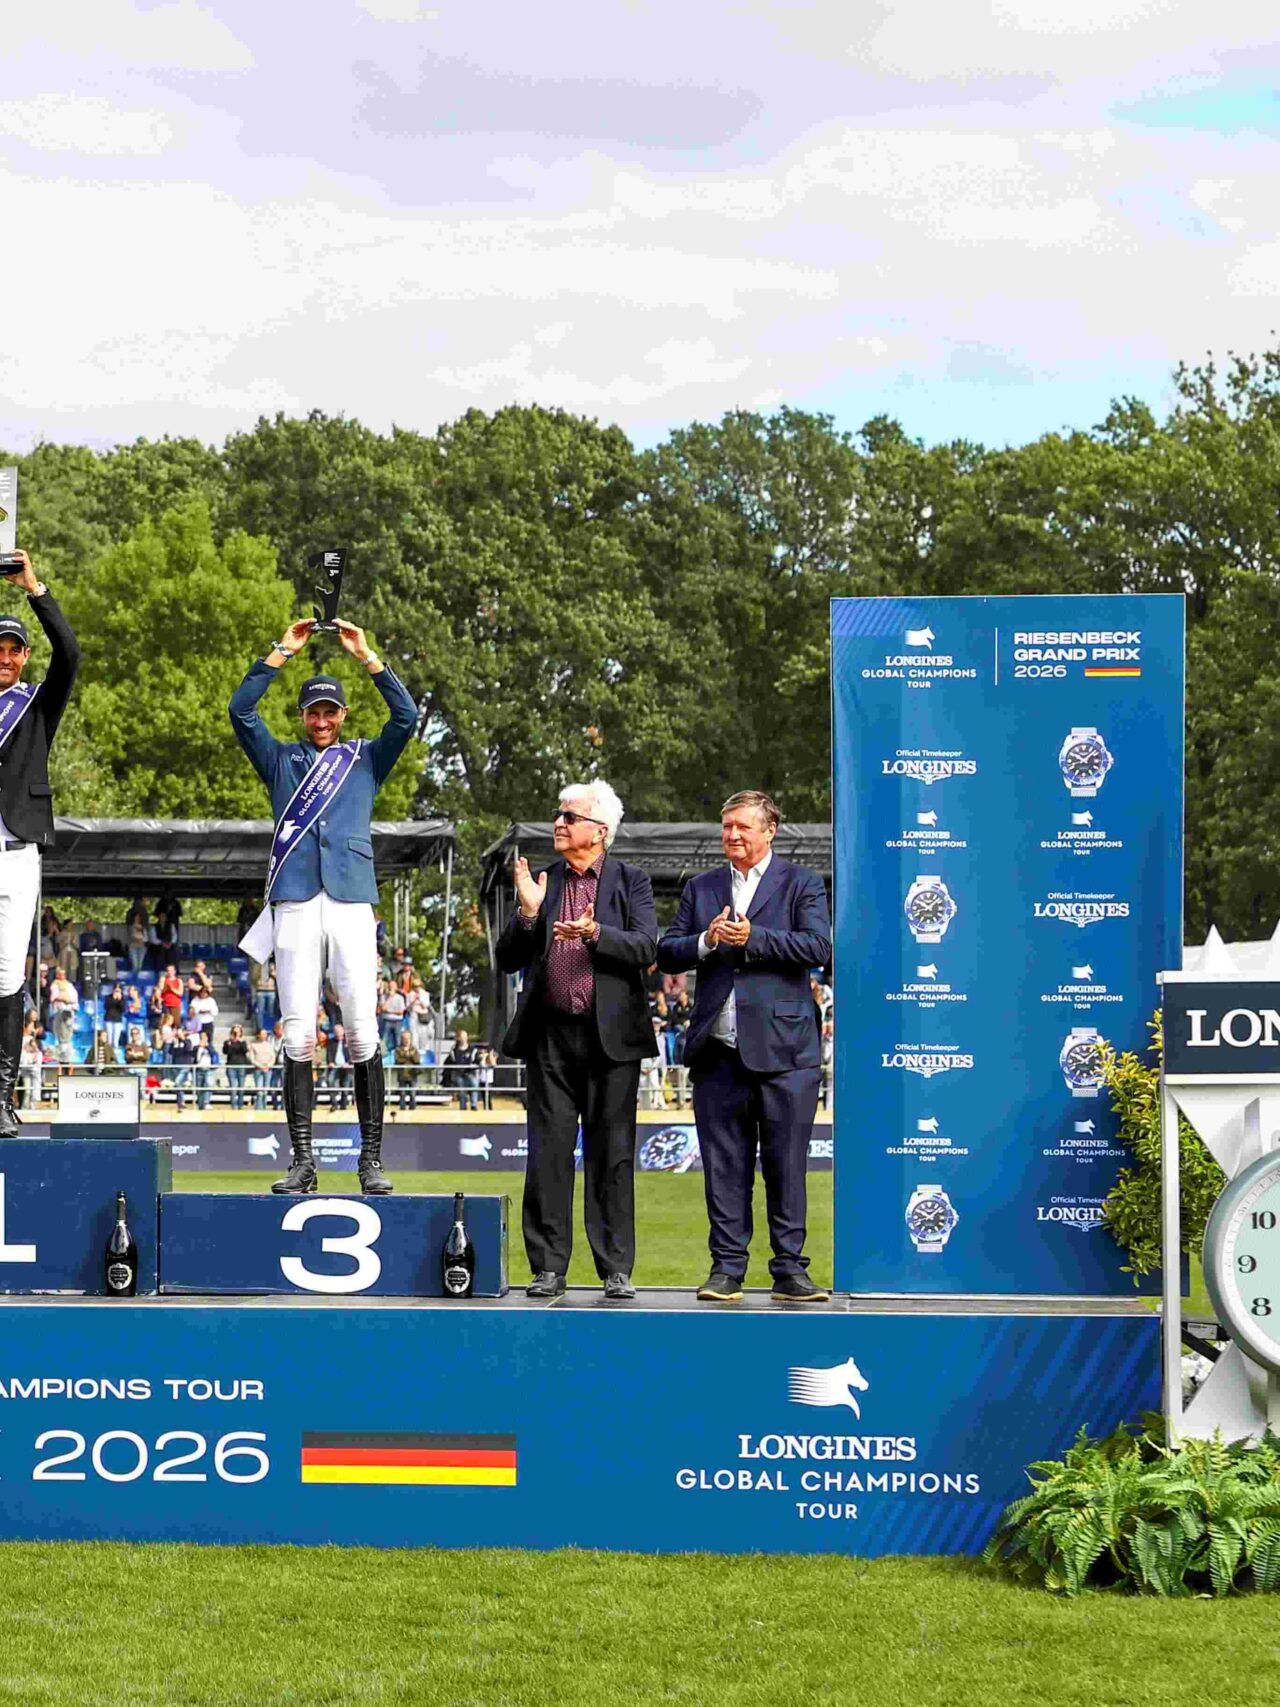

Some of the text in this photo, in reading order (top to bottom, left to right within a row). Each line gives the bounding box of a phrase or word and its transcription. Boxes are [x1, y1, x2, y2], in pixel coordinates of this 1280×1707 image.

[1014, 632, 1141, 644] RIESENBECK
[886, 656, 953, 666] LONGINES
[1014, 648, 1140, 661] GRAND PRIX
[862, 669, 976, 677] GLOBAL CHAMPIONS
[1015, 665, 1066, 677] 2026
[922, 750, 962, 758] Timekeeper
[882, 761, 976, 775] LONGINES
[903, 831, 950, 839] LONGINES
[1034, 903, 1129, 917] LONGINES
[903, 984, 950, 992] LONGINES
[1058, 985, 1106, 993] LONGINES
[882, 1054, 974, 1068] LONGINES
[75, 1091, 124, 1099] LONGINES
[904, 1138, 951, 1146] LONGINES
[1251, 1211, 1276, 1229] 10
[280, 1198, 382, 1294] 3
[1237, 1255, 1256, 1274] 9
[1251, 1298, 1272, 1316] 8
[164, 1379, 263, 1400] TOUR
[739, 1435, 916, 1461] LONGINES
[33, 1430, 269, 1483] 2026
[676, 1469, 979, 1493] GLOBAL CHAMPIONS
[796, 1503, 857, 1519] TOUR
